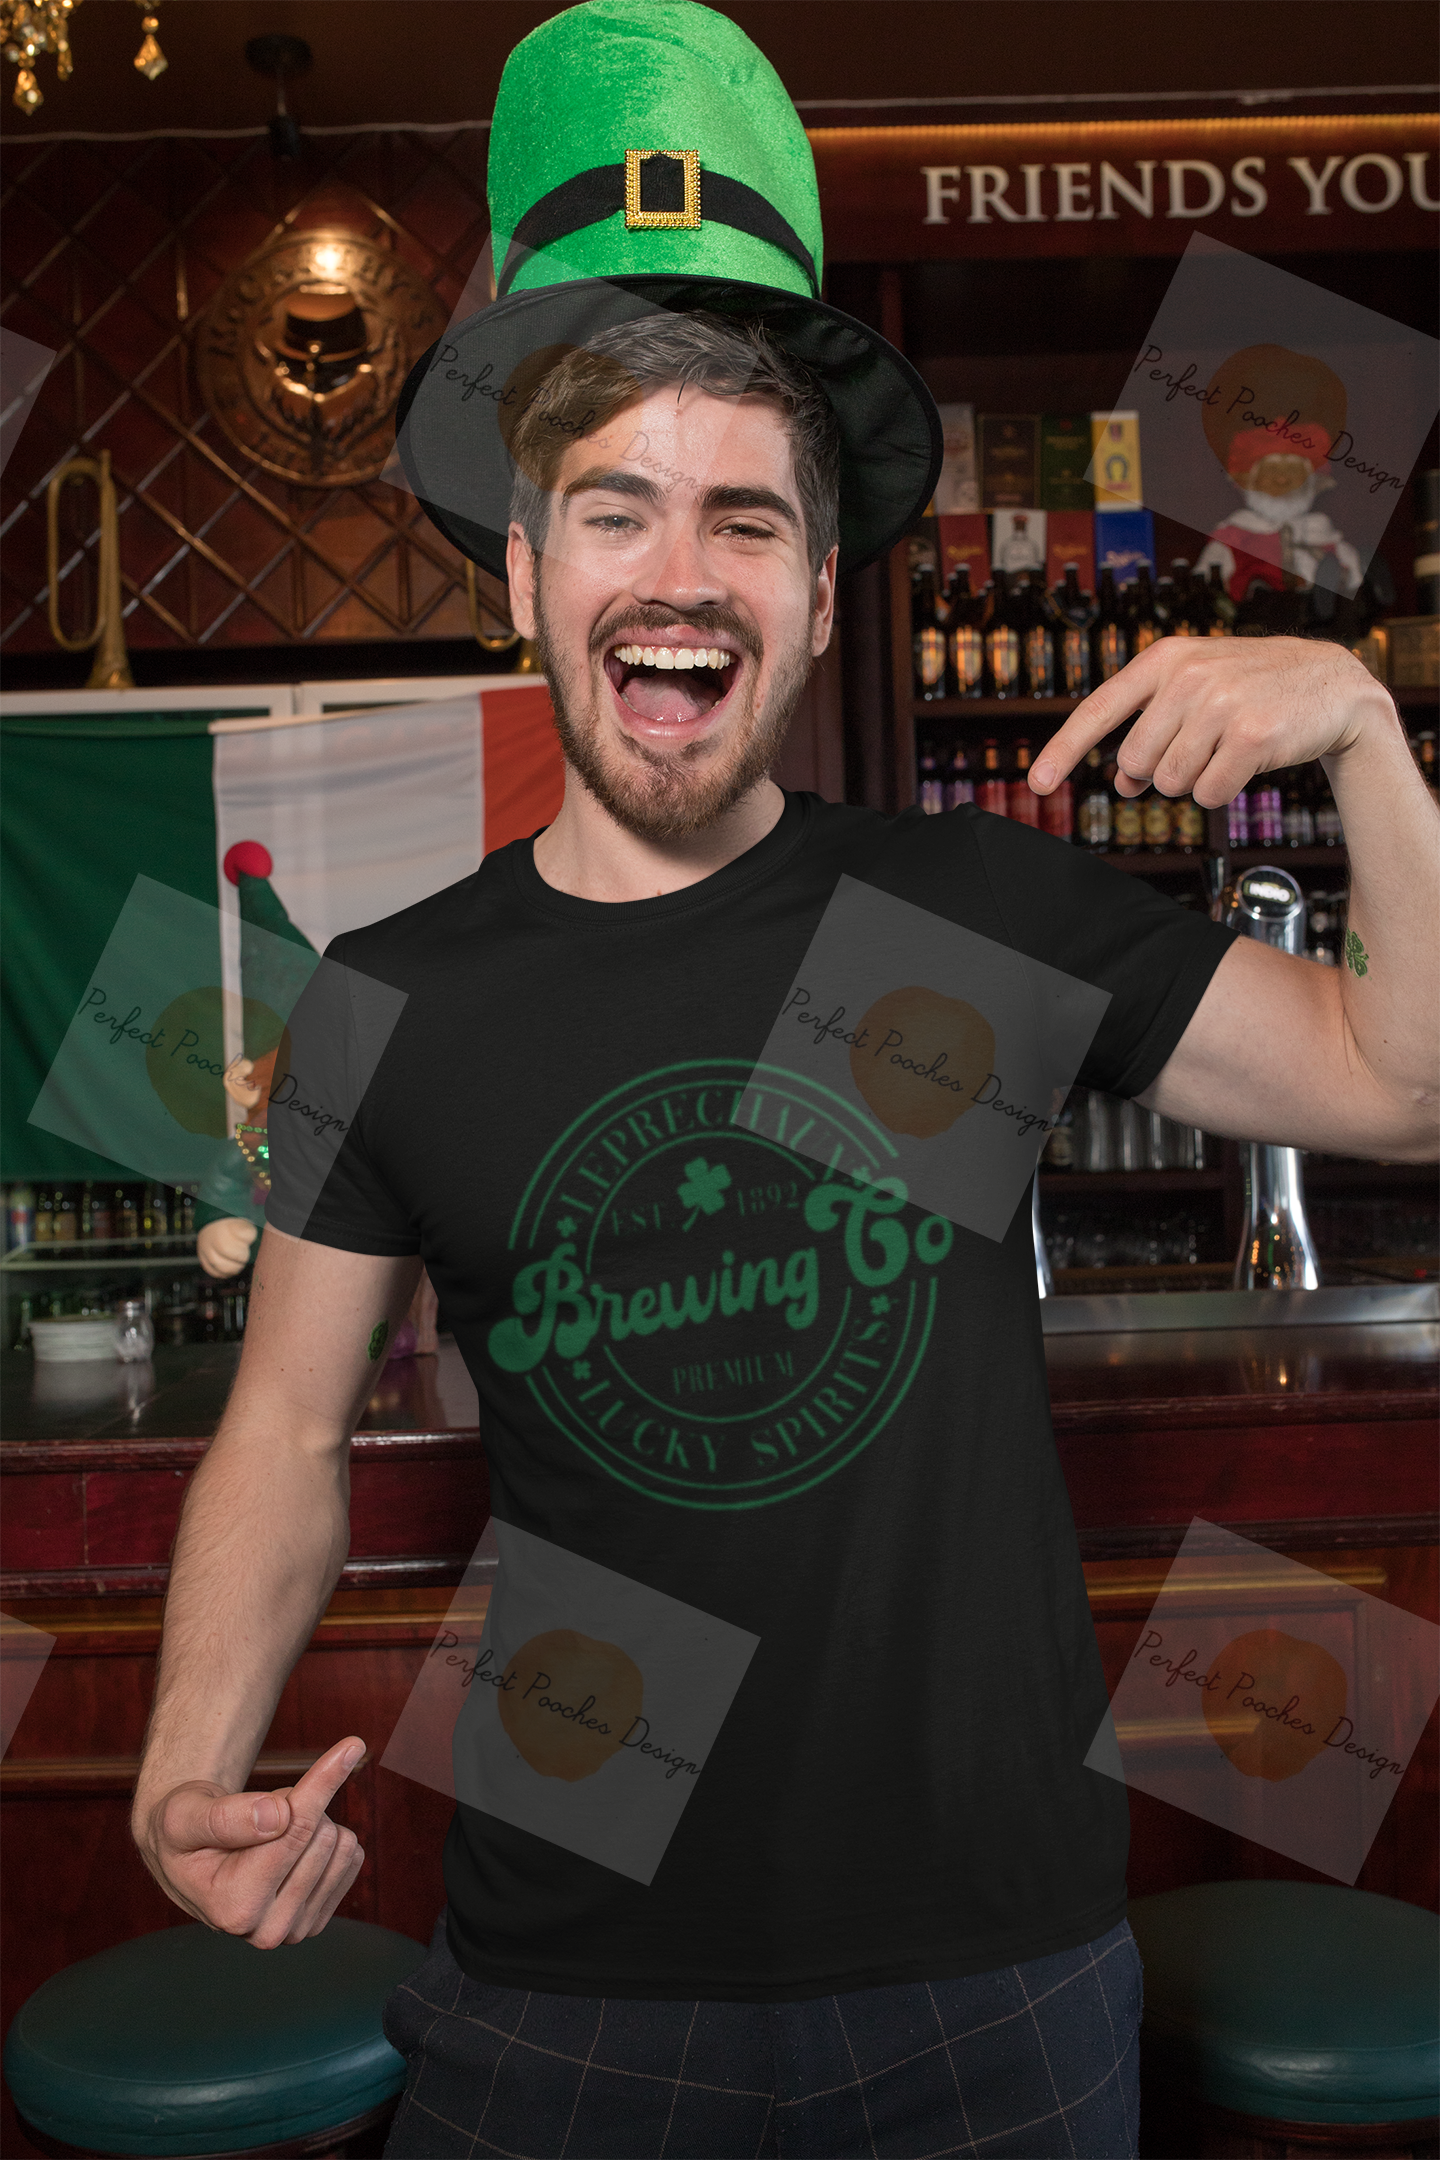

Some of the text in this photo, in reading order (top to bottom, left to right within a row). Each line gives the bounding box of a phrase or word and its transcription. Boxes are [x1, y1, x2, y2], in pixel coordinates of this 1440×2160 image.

[920, 156, 1268, 225] FRIENDS
[559, 1089, 858, 1214] LEPRECHAUN
[737, 1180, 800, 1217] 1892
[487, 1176, 955, 1373] Brewing Co
[577, 1319, 890, 1473] LUCKY SPIRITS
[672, 1350, 794, 1395] PREMIUM
